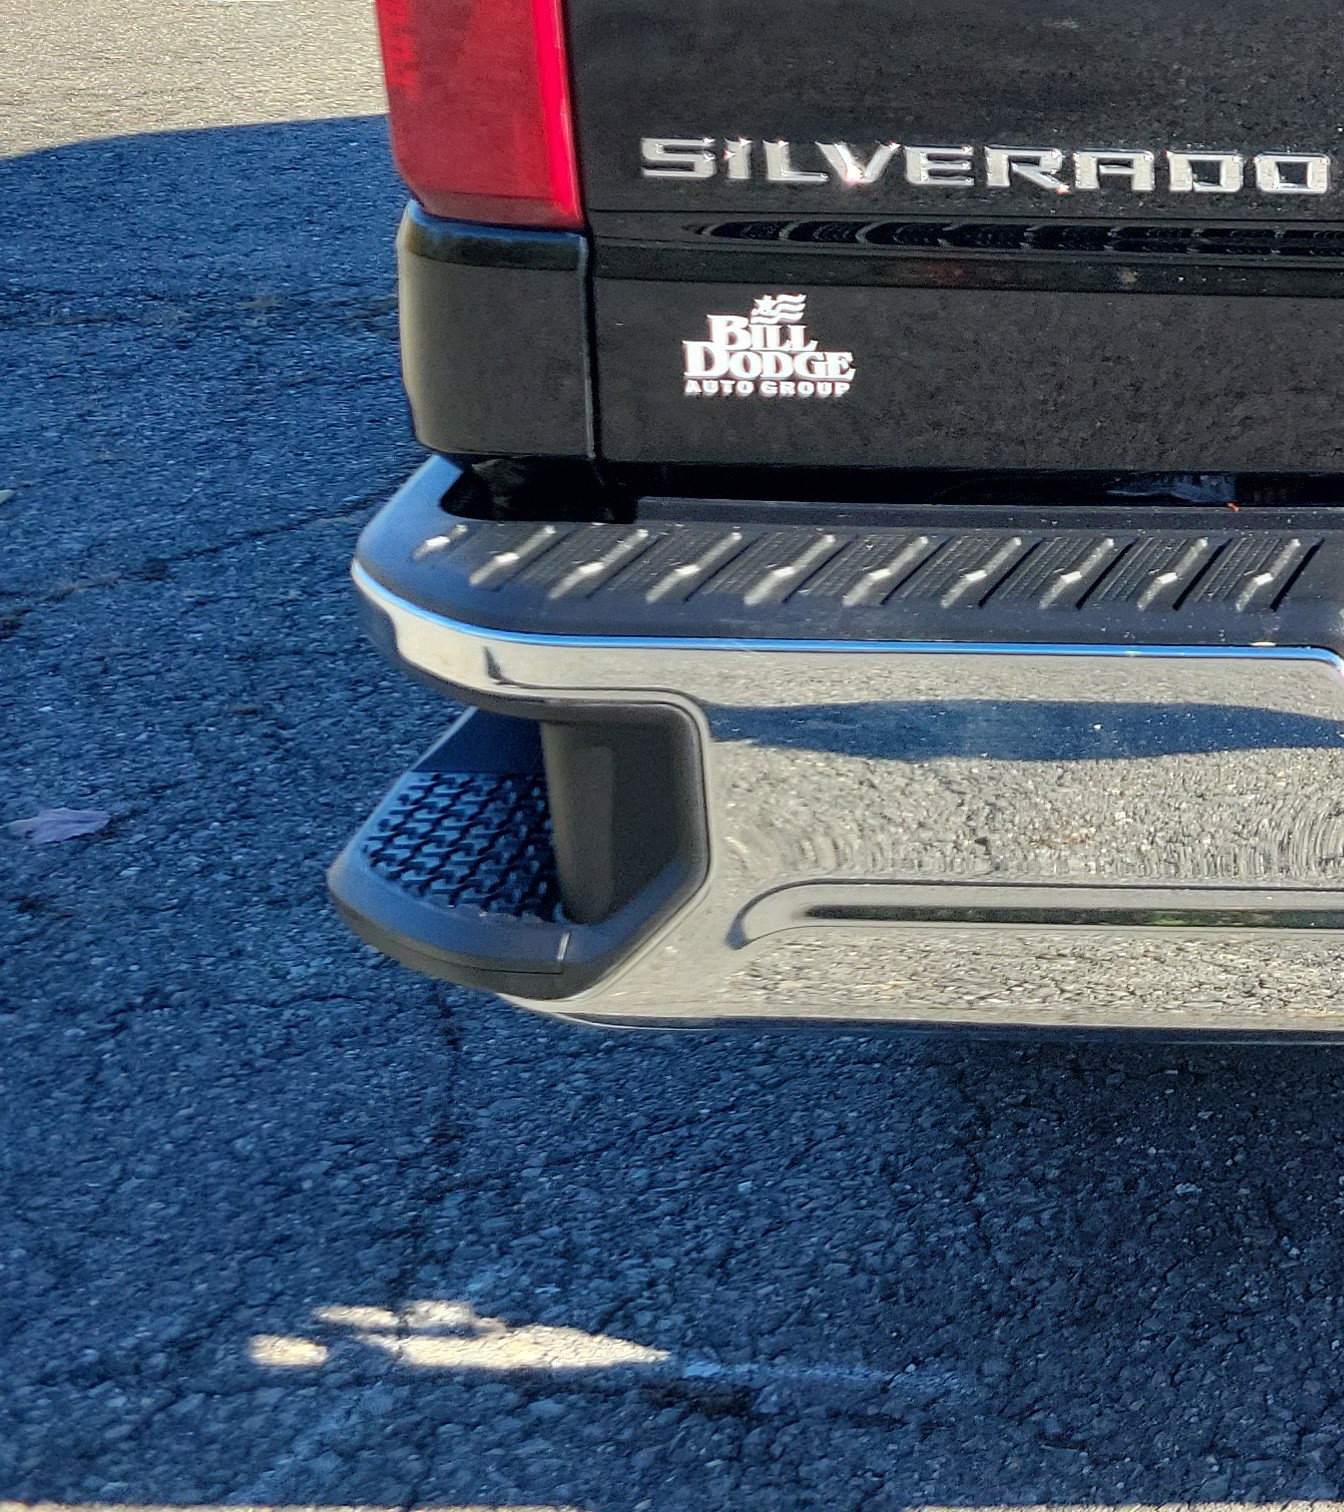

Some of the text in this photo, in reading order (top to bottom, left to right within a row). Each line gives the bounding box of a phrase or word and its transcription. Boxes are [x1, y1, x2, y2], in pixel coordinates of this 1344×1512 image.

[640, 135, 1332, 195] SILVERADO
[706, 314, 819, 352] BILL
[682, 340, 857, 381] DODGE
[684, 379, 852, 398] AUTO GROUP
